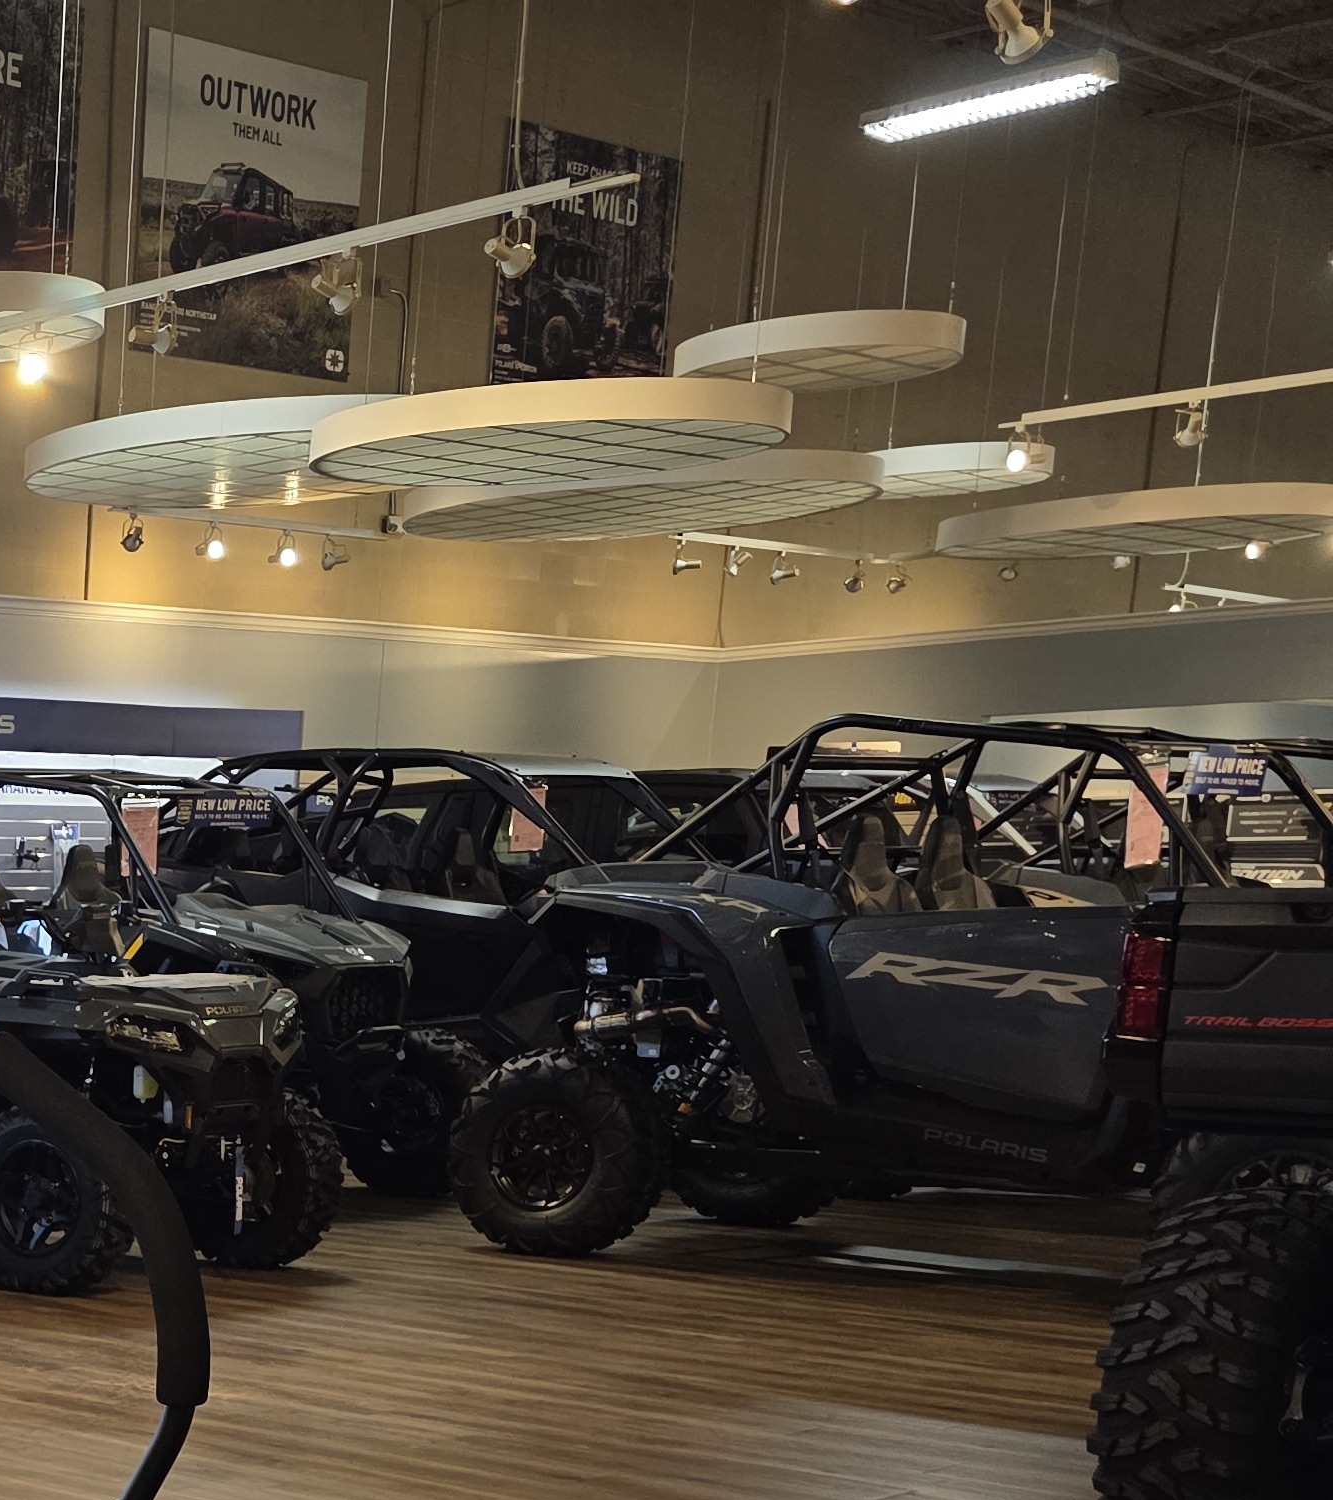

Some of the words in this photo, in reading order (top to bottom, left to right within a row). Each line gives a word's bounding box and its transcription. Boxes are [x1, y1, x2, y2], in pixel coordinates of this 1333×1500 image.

[200, 73, 317, 131] OUTWORK
[232, 121, 260, 142] THEM
[262, 129, 282, 147] ALL
[566, 160, 588, 177] KEEP
[551, 192, 585, 216] THE
[592, 189, 639, 227] WILD
[1216, 757, 1235, 774] LOW
[1235, 758, 1265, 775] PRICE
[196, 798, 215, 811] NEW
[216, 799, 236, 811] LOW
[238, 799, 271, 812] PRICE
[845, 951, 1111, 1007] RZR
[1184, 1015, 1253, 1028] TRAIL
[1256, 1017, 1333, 1029] BOSS
[923, 1127, 1048, 1163] POLARIS
